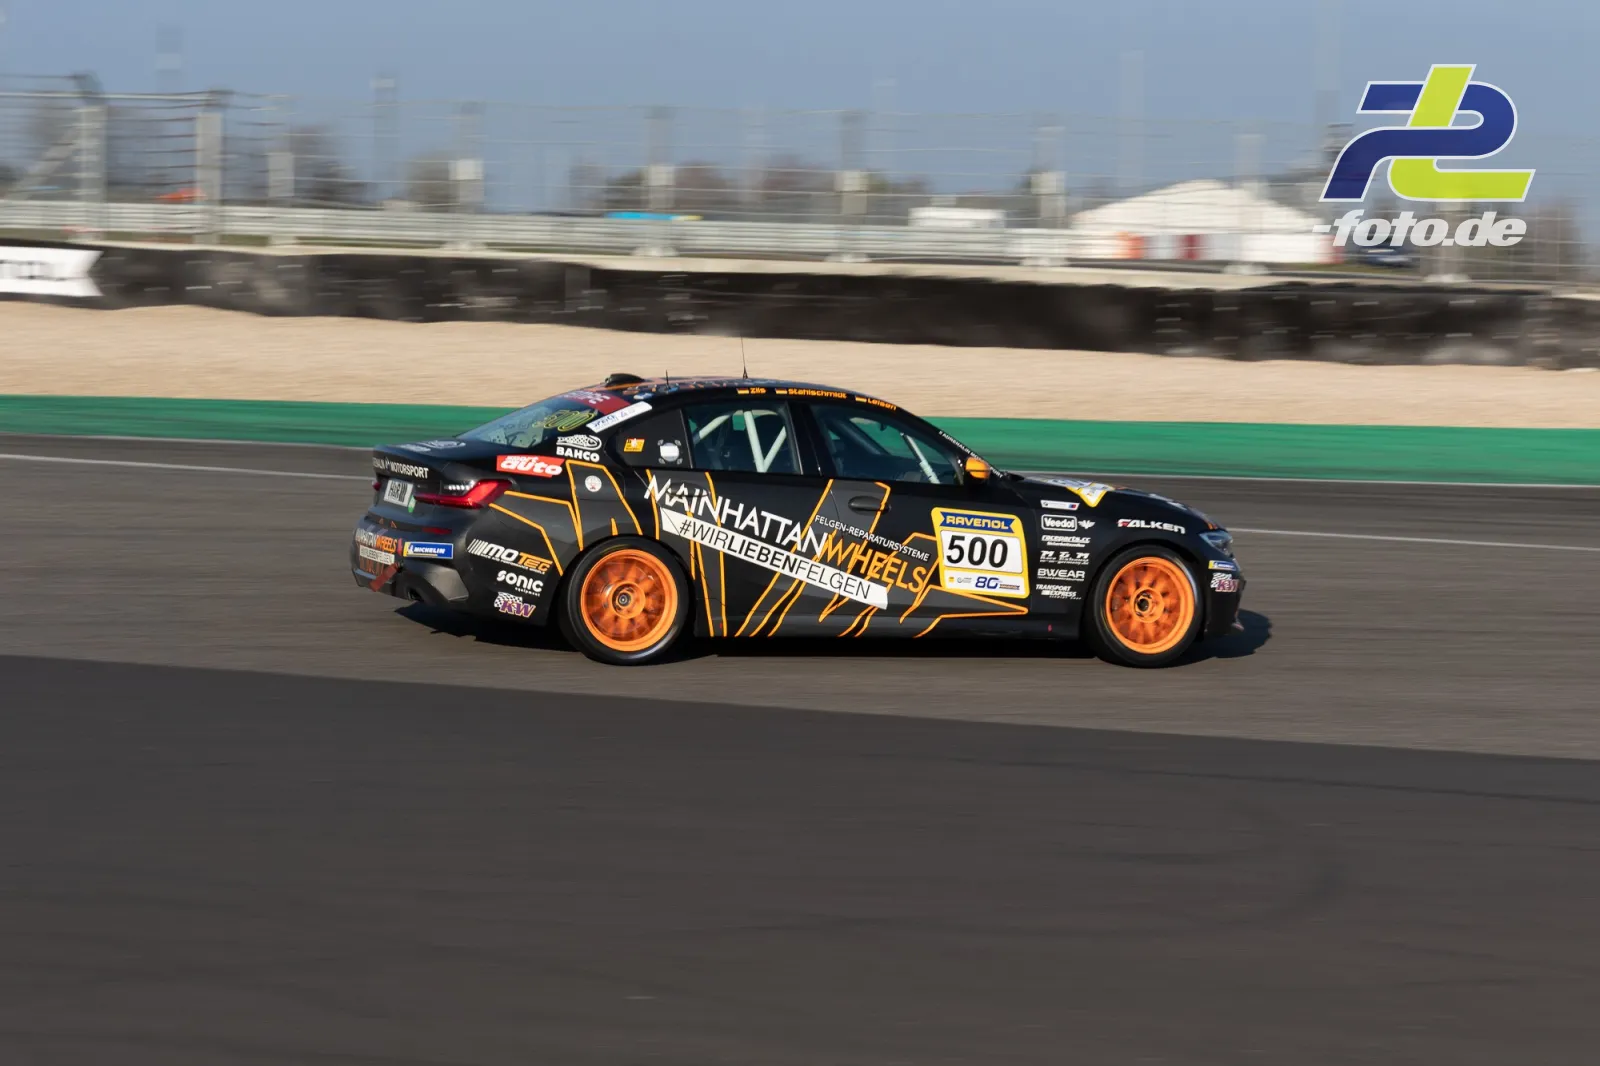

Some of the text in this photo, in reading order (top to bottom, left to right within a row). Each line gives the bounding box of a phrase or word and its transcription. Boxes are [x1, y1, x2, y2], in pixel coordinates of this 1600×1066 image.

[556, 447, 600, 463] BAHCO
[391, 462, 429, 479] MOTORSPORT
[500, 459, 563, 476] auto
[946, 515, 1009, 530] RAVENOL
[1044, 517, 1076, 529] Veedol
[1116, 518, 1186, 535] FALKEN
[644, 474, 927, 593] MAINHATTAN WHEELS
[815, 514, 930, 562] FELGEN-REPARATURSYSTEME
[414, 546, 446, 555] MICHELIN
[946, 535, 1008, 568] 500
[679, 519, 871, 600] #WIRLIEBENFELGEN
[1037, 568, 1086, 579] BWEAR
[1035, 583, 1072, 592] TRANSPORT
[499, 600, 536, 618] KW
